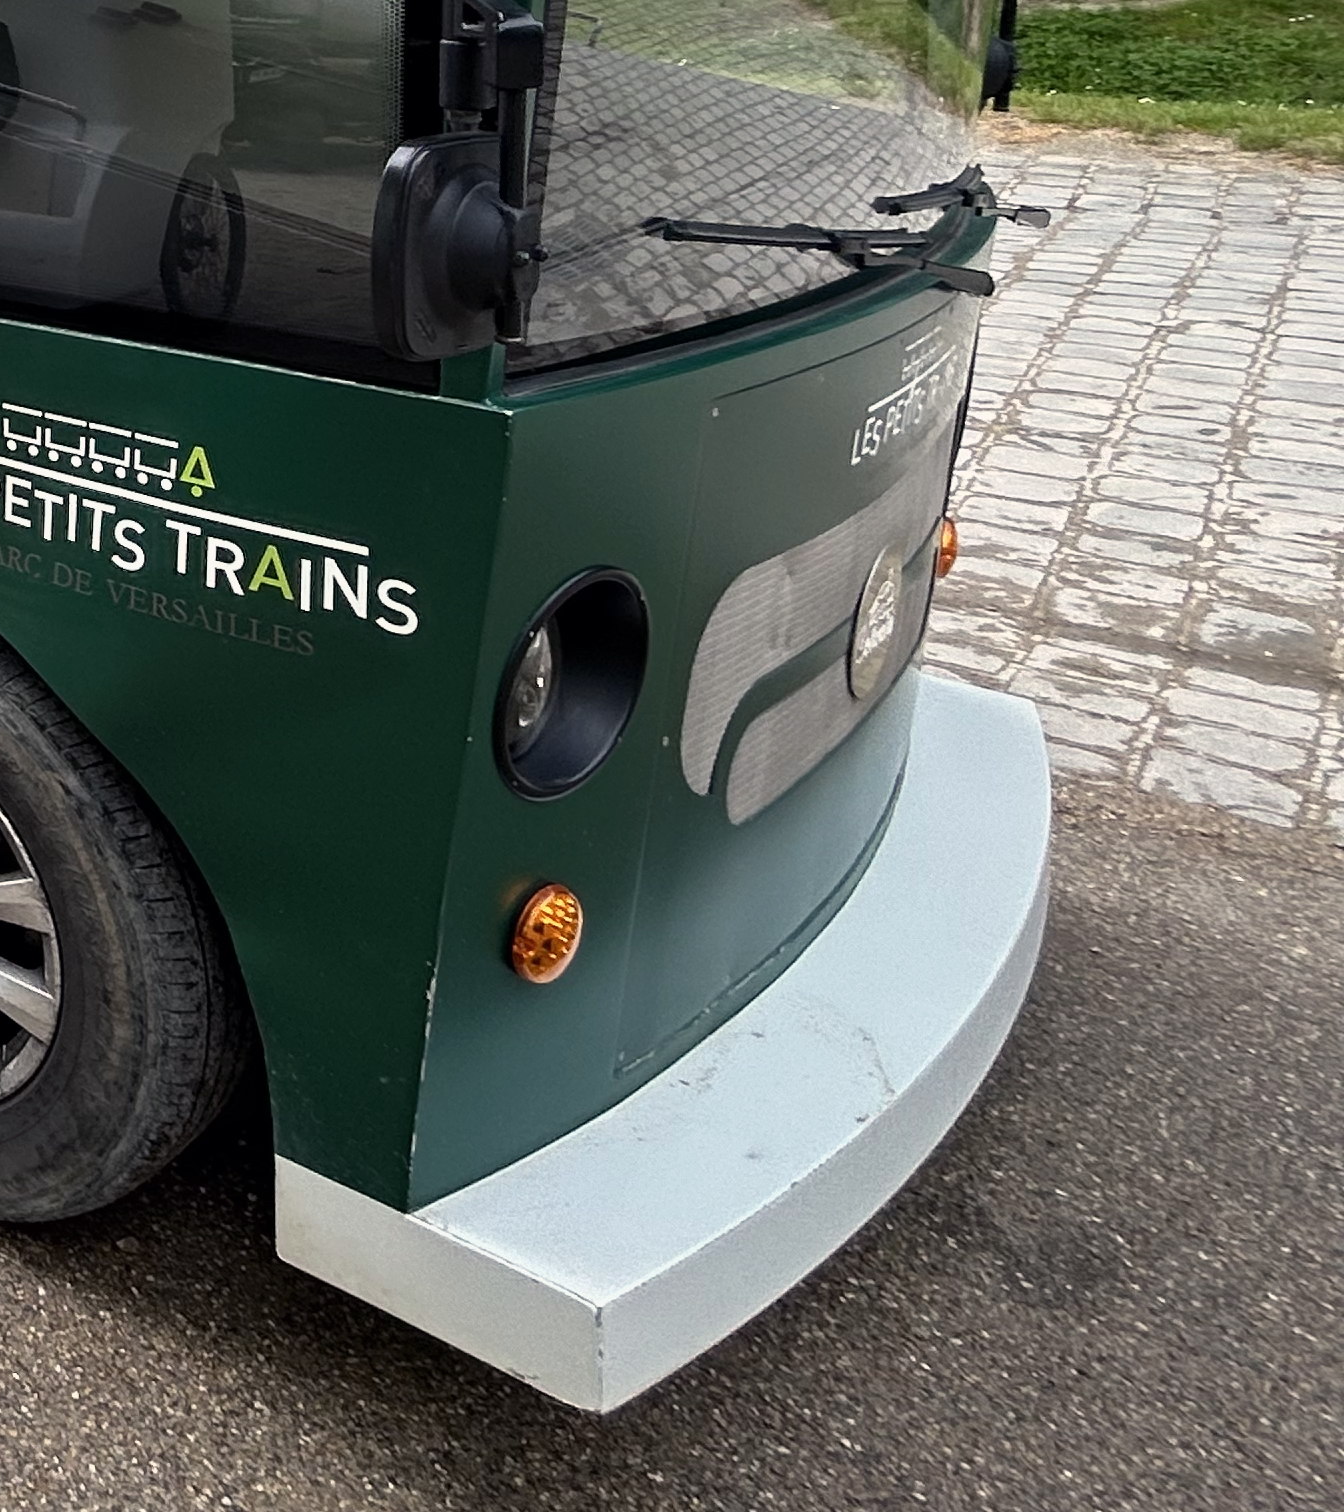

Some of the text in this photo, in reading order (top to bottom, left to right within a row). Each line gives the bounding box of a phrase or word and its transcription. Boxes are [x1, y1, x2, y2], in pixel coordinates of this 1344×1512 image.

[850, 416, 884, 466] LES
[51, 560, 95, 598] DE
[105, 577, 315, 657] VERSAILLES
[165, 518, 420, 636] TRAINS
